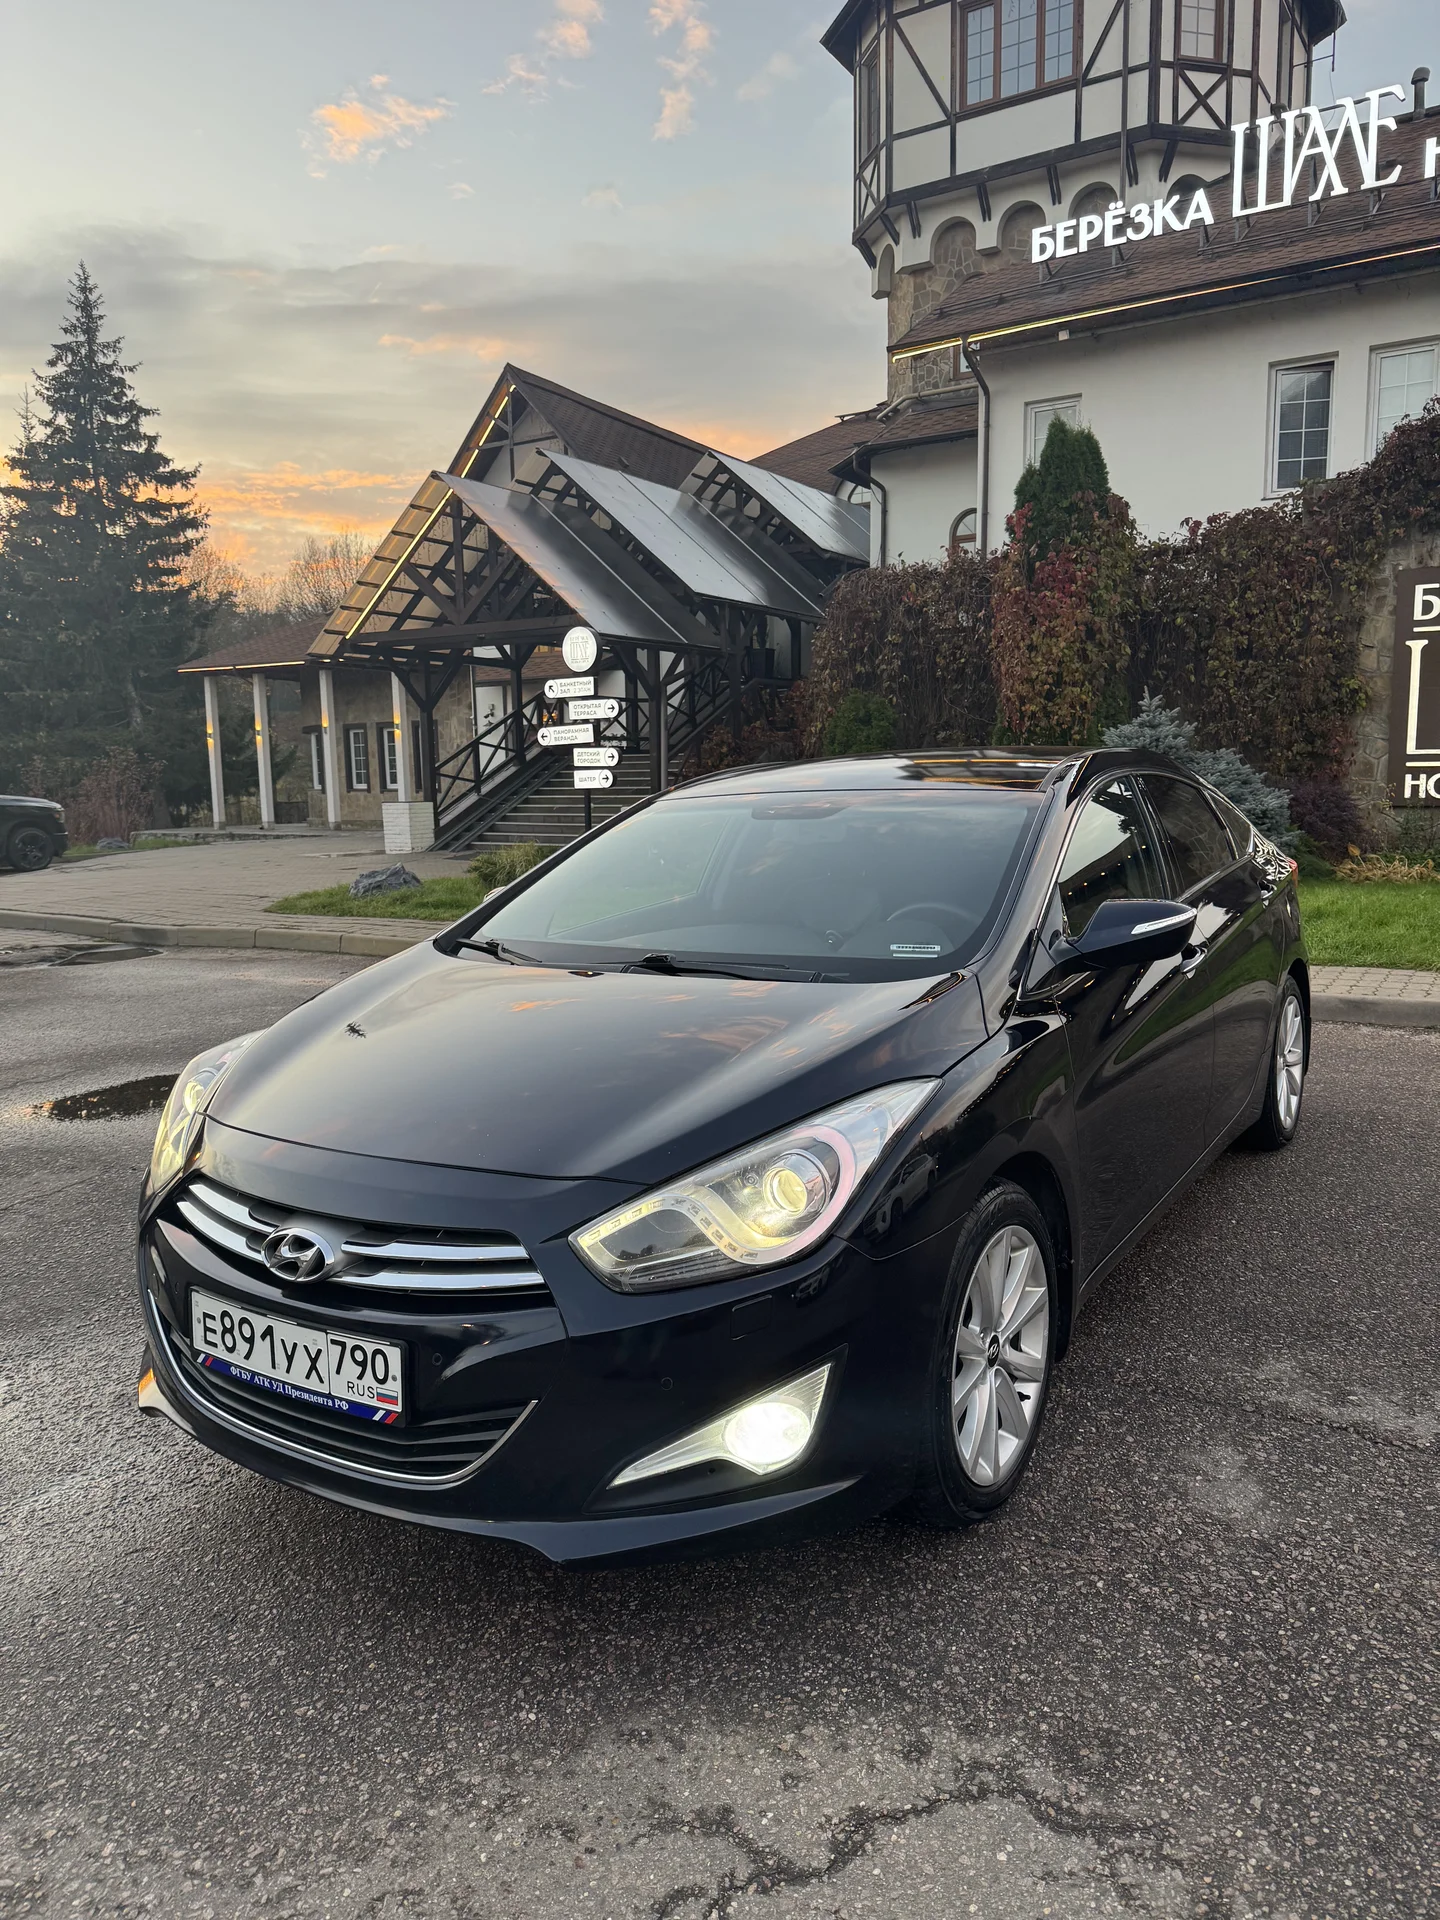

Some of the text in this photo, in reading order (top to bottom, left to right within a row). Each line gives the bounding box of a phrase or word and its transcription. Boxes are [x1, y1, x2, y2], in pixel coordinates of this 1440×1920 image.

[1031, 83, 1407, 264] БЕРЁЗКА ШАЛЕ
[560, 679, 592, 687] БАНКЕТНЫЙ
[553, 727, 590, 735] ПАНОРАМНАЯ
[330, 1338, 389, 1386] 790
[230, 1366, 349, 1410] ФГБУ АТК УД Президента РФ
[347, 1380, 375, 1399] RUS
